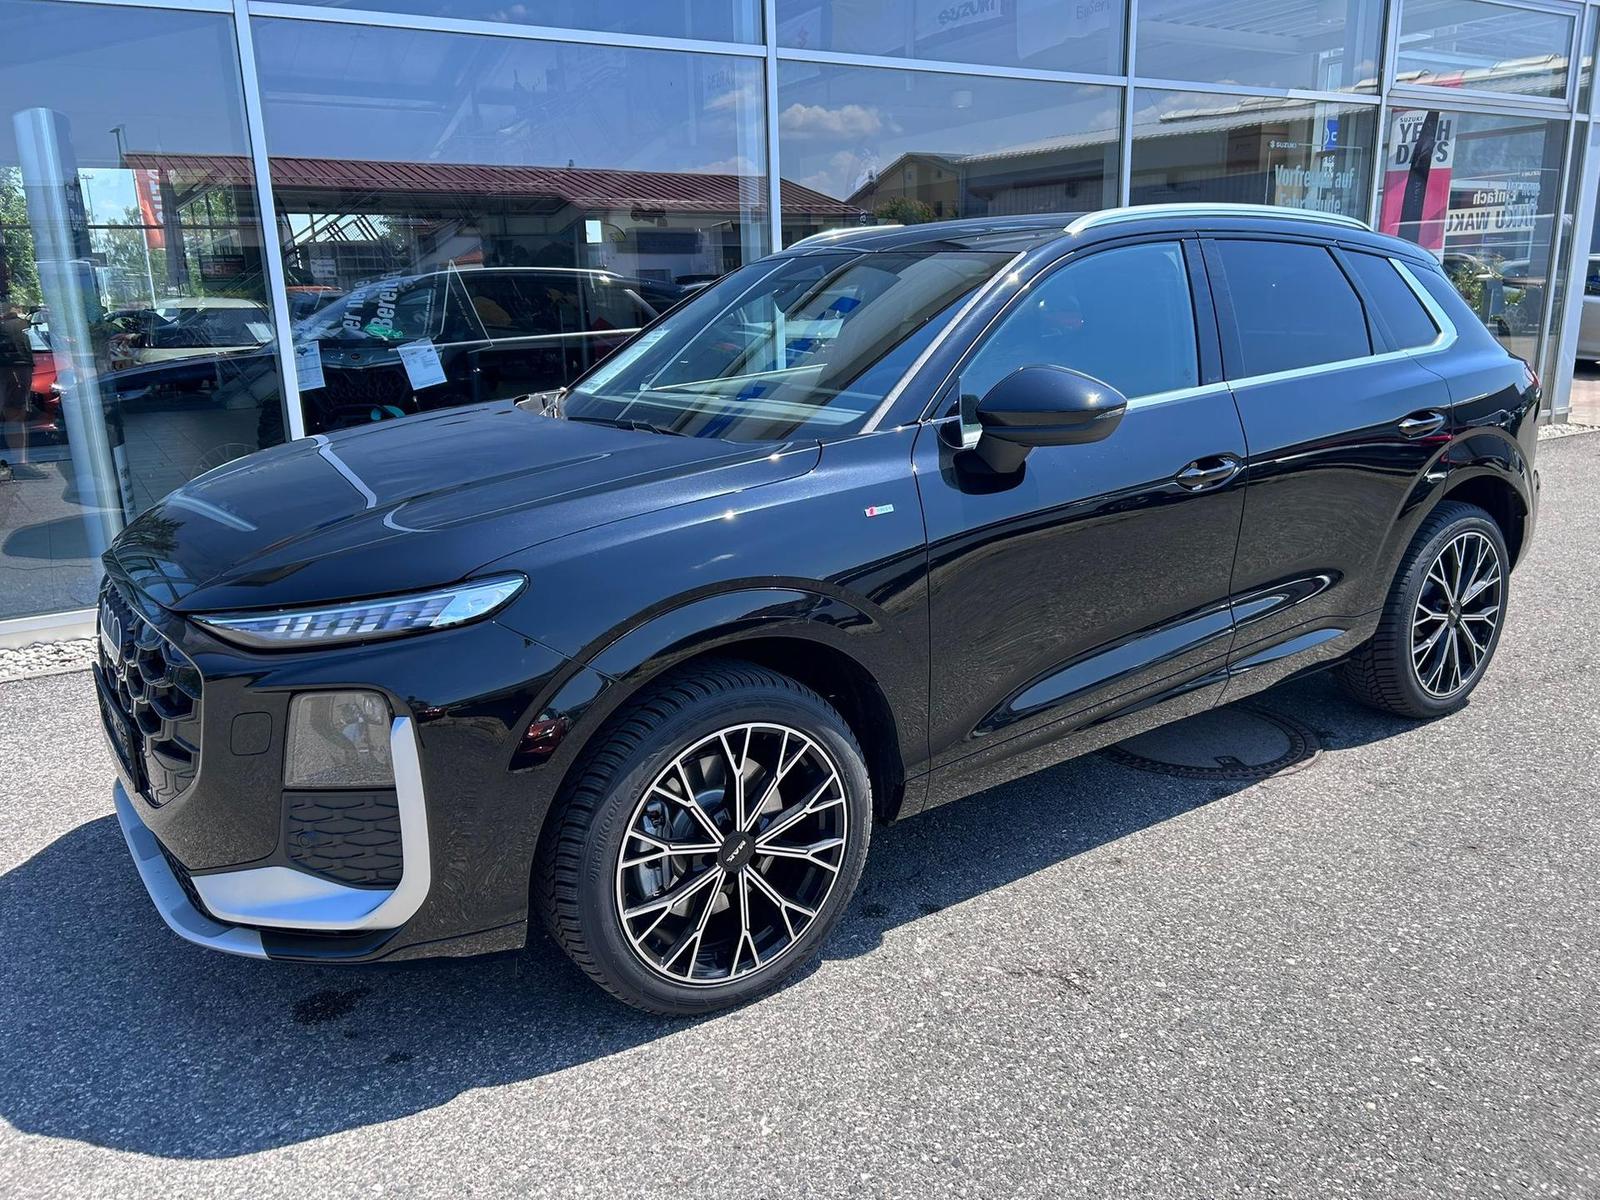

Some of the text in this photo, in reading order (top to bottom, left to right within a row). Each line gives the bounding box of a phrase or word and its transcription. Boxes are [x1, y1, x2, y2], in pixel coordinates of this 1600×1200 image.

[1400, 119, 1452, 143] YEH
[1276, 141, 1297, 149] SUZUKI
[1395, 141, 1449, 165] DS
[1275, 164, 1333, 189] Vorfre
[1334, 167, 1355, 189] auf
